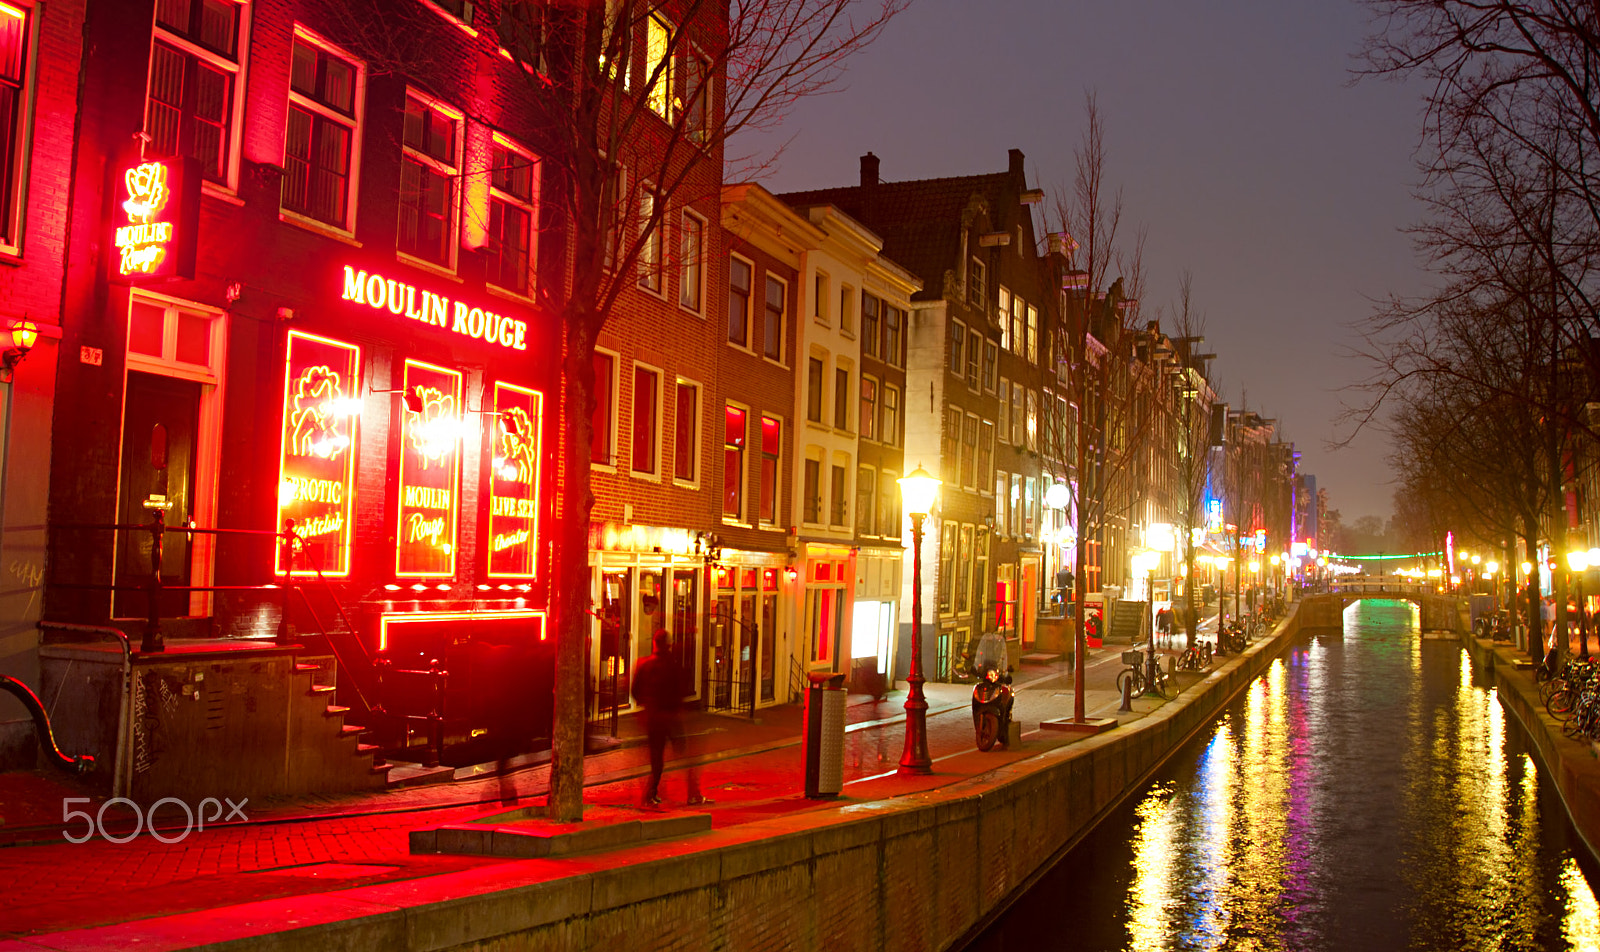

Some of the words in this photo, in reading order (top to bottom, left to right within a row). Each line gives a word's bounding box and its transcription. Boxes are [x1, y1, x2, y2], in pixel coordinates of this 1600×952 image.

[115, 222, 171, 247] MOULIN
[342, 265, 449, 328] MOULIN
[452, 301, 527, 351] ROUGE
[290, 476, 342, 504] EROTIC
[405, 486, 450, 510] MOULIN
[492, 496, 516, 517] LIVE
[516, 498, 535, 519] SEX
[283, 511, 344, 551] ghtclub
[410, 513, 445, 546] Rouge
[494, 529, 530, 552] theater
